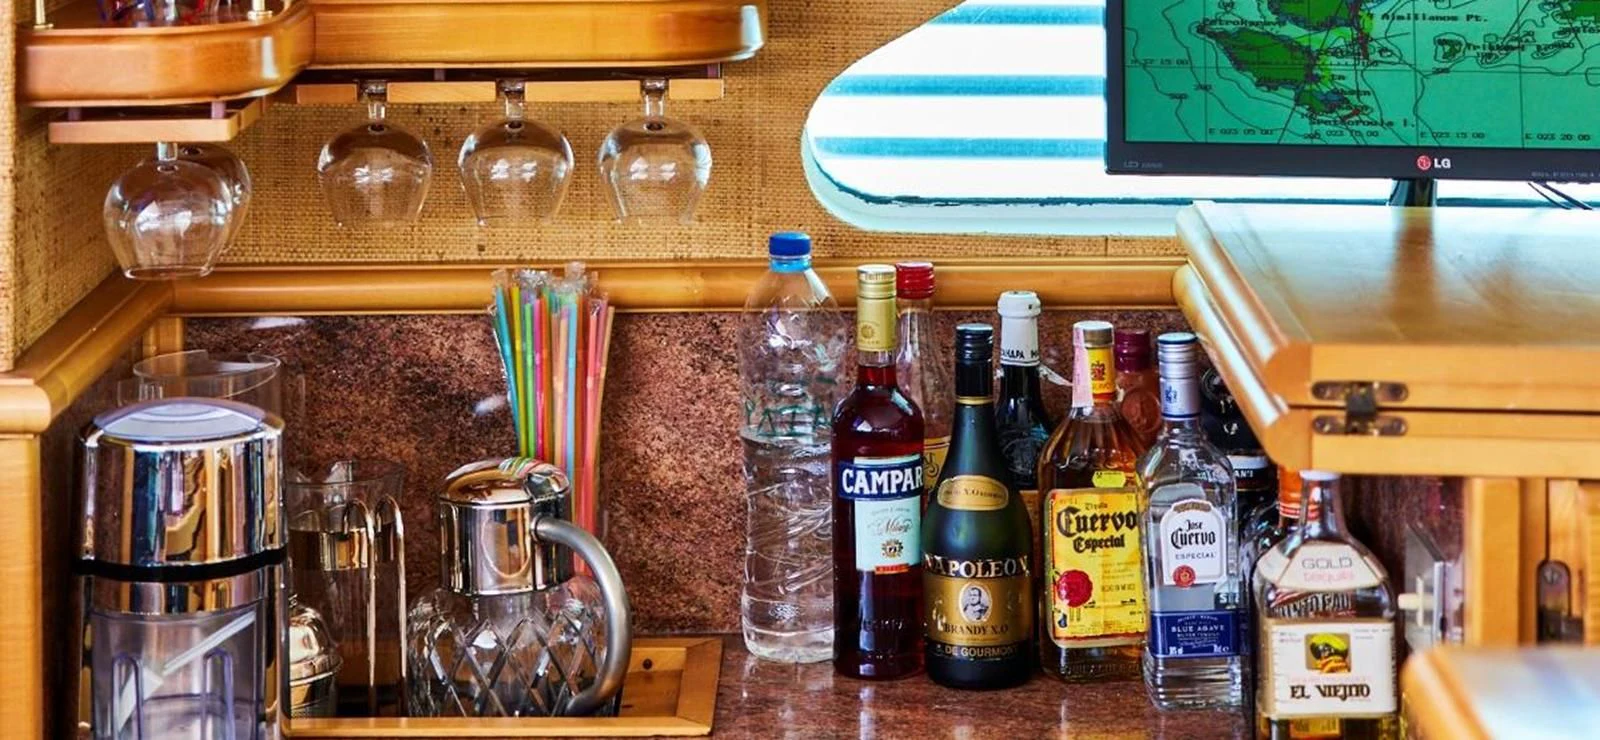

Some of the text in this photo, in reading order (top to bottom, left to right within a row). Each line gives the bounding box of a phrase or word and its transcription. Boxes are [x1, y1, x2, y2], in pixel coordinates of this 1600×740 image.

[1466, 13, 1488, 22] Pt.
[1472, 132, 1485, 140] 00
[1433, 158, 1451, 169] LG
[841, 462, 923, 495] CAMPAR
[1056, 505, 1138, 538] Cuervo
[1073, 533, 1125, 554] Especial
[1171, 527, 1216, 550] Cuervo
[1175, 551, 1216, 561] ESPECIAL
[1301, 556, 1353, 570] GOLD
[944, 623, 988, 636] BRANDY
[1171, 624, 1193, 633] BLUE
[1197, 623, 1225, 633] AGAVE
[945, 645, 959, 657] DE
[1290, 683, 1371, 702] EL VIEJITO
